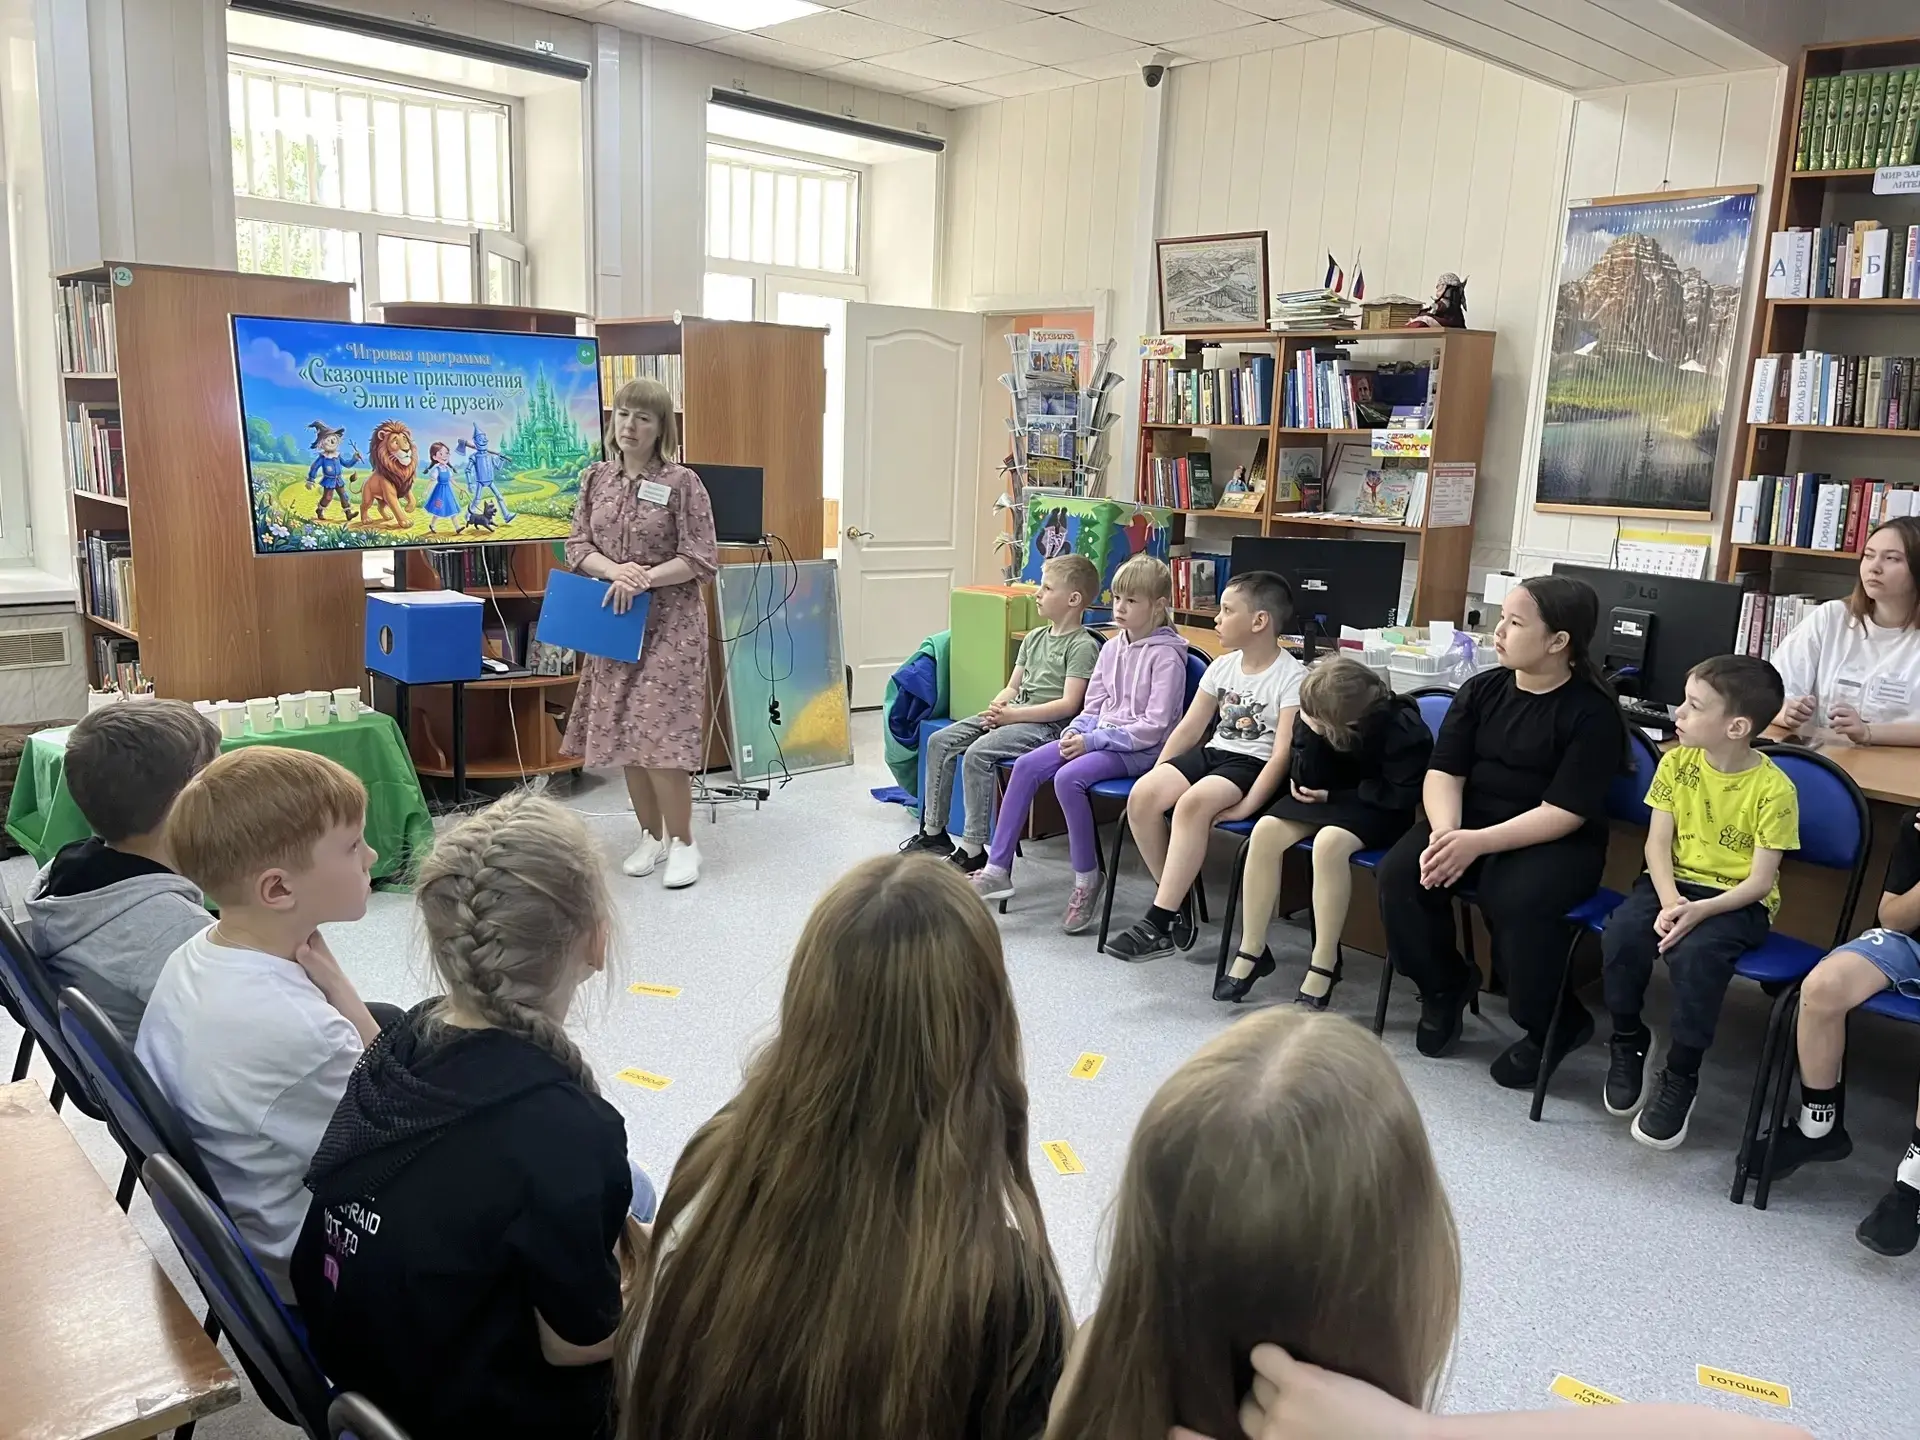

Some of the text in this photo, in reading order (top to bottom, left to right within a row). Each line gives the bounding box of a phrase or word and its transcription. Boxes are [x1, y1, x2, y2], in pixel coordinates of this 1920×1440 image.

[1880, 172, 1902, 180] МИР
[1769, 258, 1786, 277] А
[1790, 250, 1803, 297] АНДЕРСЕН
[1867, 255, 1881, 275] Б
[1033, 331, 1075, 343] Мурзилка
[345, 342, 491, 368] Игровая программа
[299, 357, 523, 394] «Сказочные приключения
[352, 385, 504, 416] Элли и её друзей»
[1795, 362, 1808, 423] ЖЮЛЬ ВЕРН
[1387, 432, 1414, 440] СДЕЛАНО
[1736, 505, 1753, 523] Г
[1818, 508, 1833, 548] ГОФМАН
[1639, 586, 1659, 600] LG
[294, 710, 300, 719] 6
[318, 705, 326, 717] 7
[350, 700, 357, 712] 8
[266, 711, 273, 723] 5
[1811, 1110, 1834, 1123] UP
[344, 1227, 359, 1254] TO
[1708, 1374, 1779, 1399] ТОТОШКА
